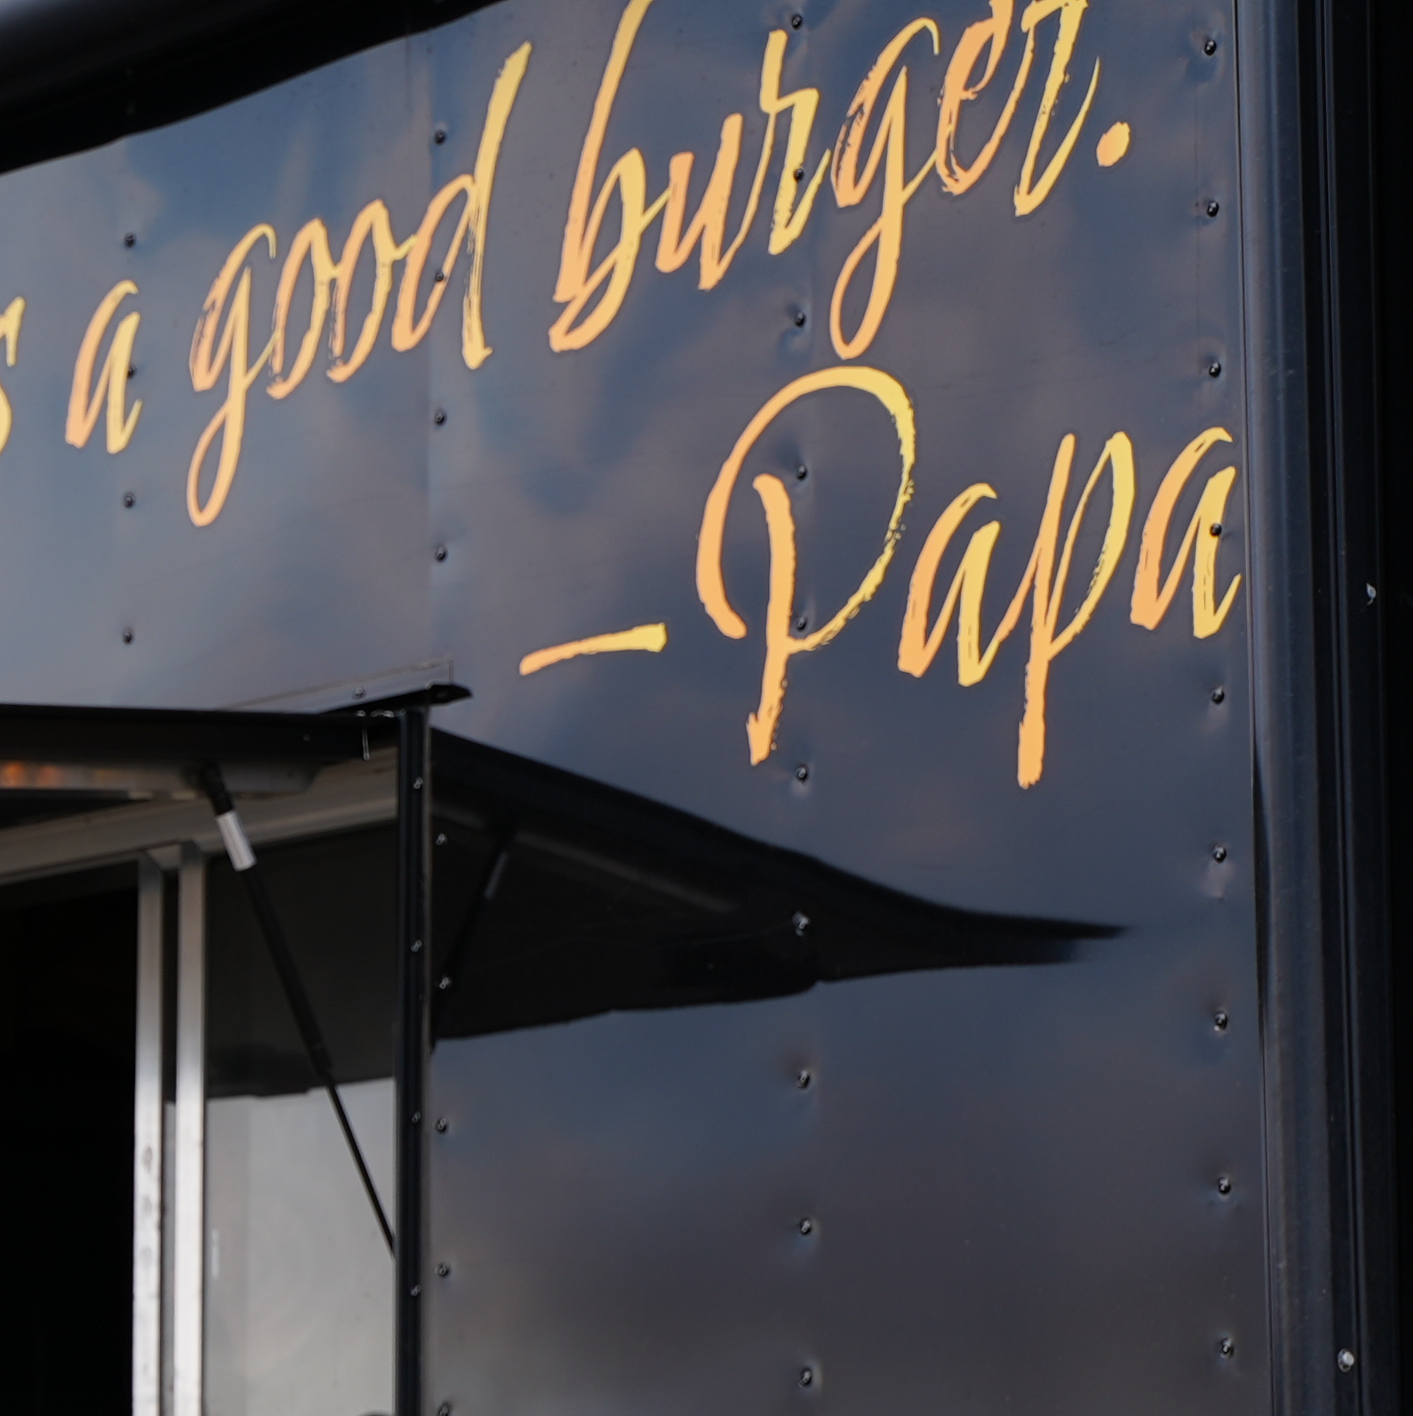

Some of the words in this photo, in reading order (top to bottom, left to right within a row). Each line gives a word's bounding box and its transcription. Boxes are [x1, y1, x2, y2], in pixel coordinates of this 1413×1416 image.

[64, 279, 143, 455] a
[187, 41, 532, 528] good
[548, 0, 1131, 361] burger.
[695, 364, 1241, 790] Papa
